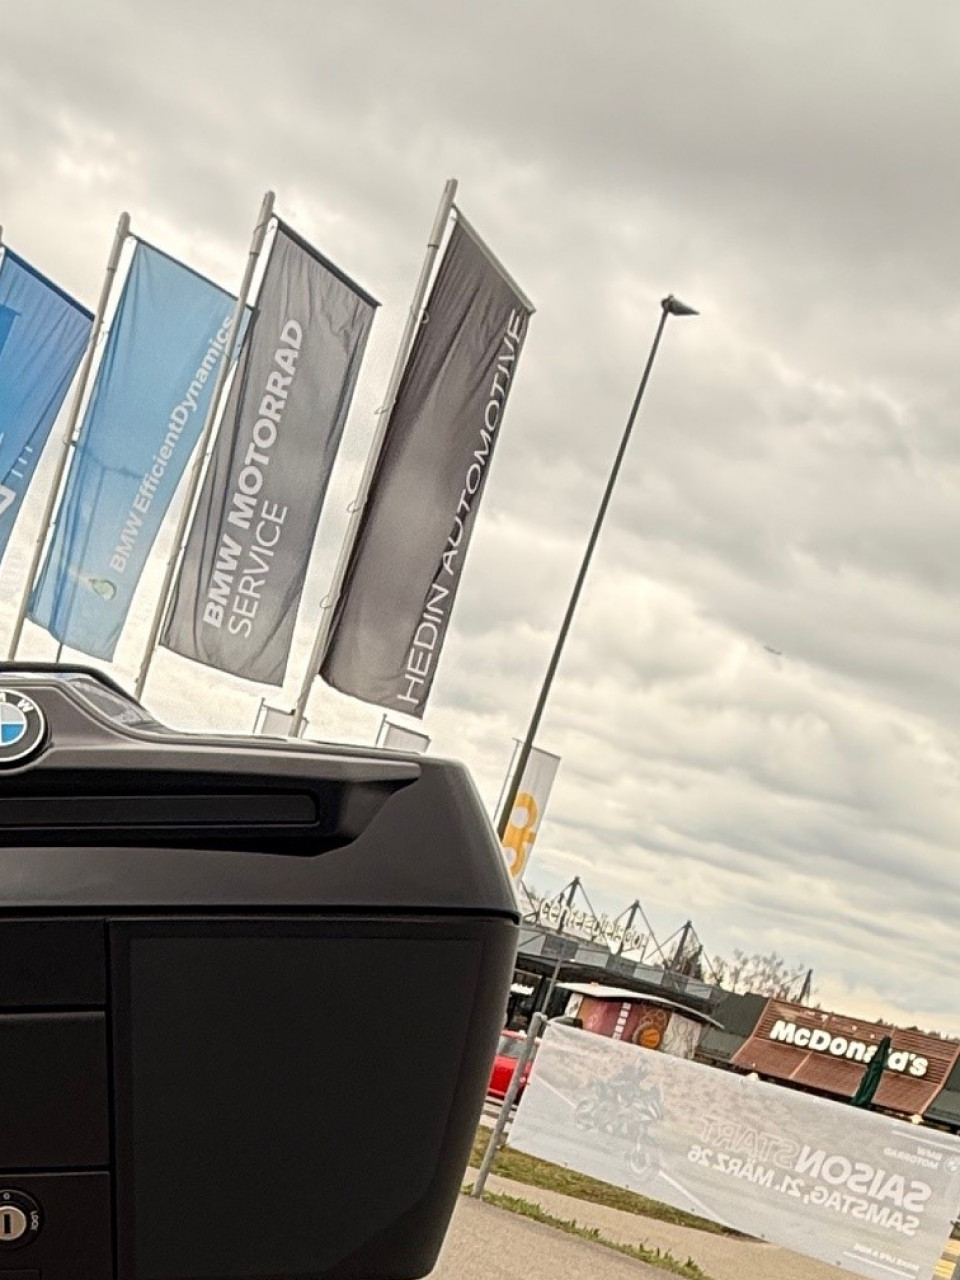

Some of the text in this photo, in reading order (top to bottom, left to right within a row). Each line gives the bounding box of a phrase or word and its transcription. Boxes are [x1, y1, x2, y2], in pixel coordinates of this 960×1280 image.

[110, 316, 233, 574] BMW EfficientDynamics
[203, 319, 303, 627] BMW MOTORRAD
[229, 499, 288, 638] SERVICE
[397, 309, 525, 705] HEDIN AUTOMOTIVE
[769, 1019, 929, 1077] McDonad's
